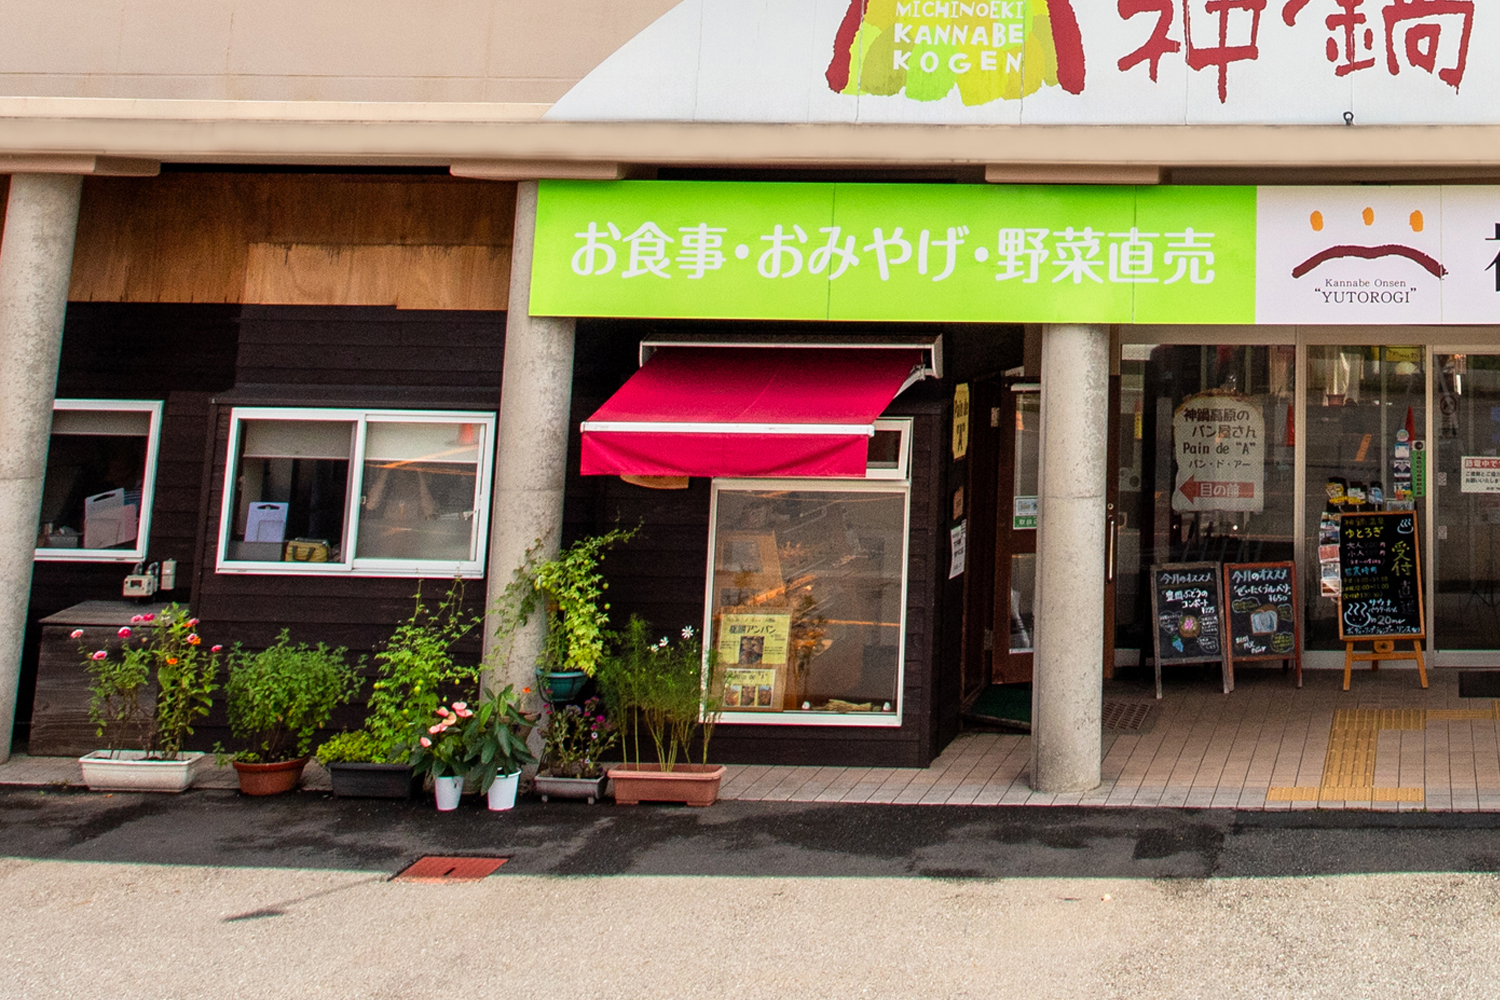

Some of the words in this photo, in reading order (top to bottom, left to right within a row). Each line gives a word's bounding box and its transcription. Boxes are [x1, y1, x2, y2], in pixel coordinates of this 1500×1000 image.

[893, 21, 1025, 46] KANNABE
[892, 48, 1024, 74] KOGEN
[570, 220, 1216, 285] お食事・おみやげ・野菜直売
[1325, 279, 1370, 287] Kannabe
[1374, 279, 1407, 287] Onsen
[1183, 408, 1250, 422] 神鍋高原の
[1192, 425, 1256, 438] パン屋さん
[1183, 443, 1210, 454] Pain
[1216, 442, 1230, 454] de
[1200, 483, 1240, 497] 目の前
[1344, 526, 1384, 539] ゆとろぎ
[1391, 540, 1413, 577] 受付
[1160, 572, 1213, 585] 今月のオススメ
[1231, 569, 1289, 583] 今月のオススメ
